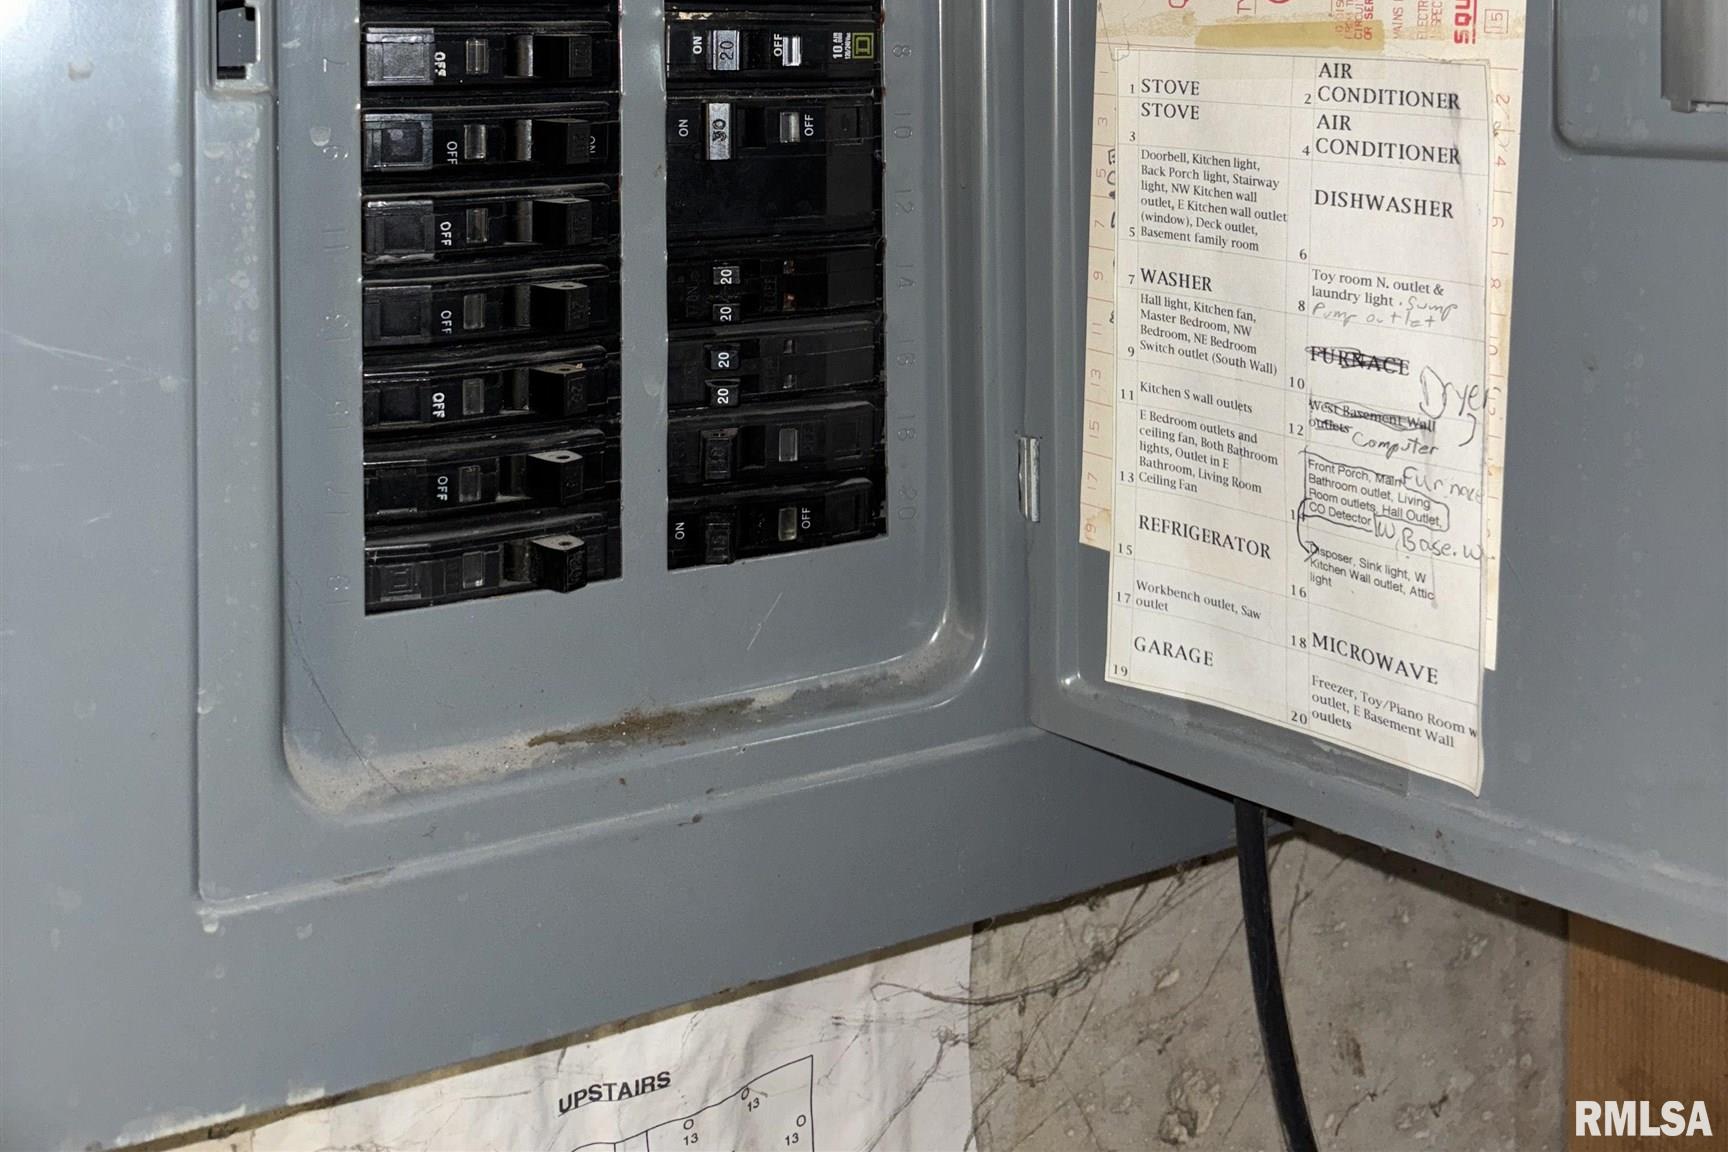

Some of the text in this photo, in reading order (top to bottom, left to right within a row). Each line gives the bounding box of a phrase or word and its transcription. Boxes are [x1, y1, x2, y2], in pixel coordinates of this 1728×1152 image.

[692, 33, 783, 61] ON 20 OFF
[1318, 62, 1352, 80] AIR
[1130, 78, 1200, 96] 1 STOVE
[1304, 85, 1461, 111] 2 CONDITIONER
[1141, 102, 1200, 120] STOVE
[1316, 114, 1352, 131] AIR
[678, 119, 689, 137] ON
[804, 114, 814, 137] OFF
[1129, 131, 1136, 142] 3
[446, 141, 458, 165] OFF
[1141, 149, 1261, 172] Doorbell, Kitchen light,
[1302, 137, 1461, 165] 4 CONDITIONER
[1141, 165, 1280, 191] Back Porch light, Stairway
[1314, 189, 1454, 219] DISHWASHER
[439, 221, 452, 246] OFF
[1129, 226, 1259, 252] 5 Basement family room
[1299, 249, 1308, 261] 6
[720, 268, 733, 285] 20
[1128, 268, 1213, 292] 7 WASHER
[1312, 268, 1445, 296] Toy room N. outlet &
[1298, 300, 1306, 312] 8
[1312, 286, 1393, 307] laundry light
[720, 306, 732, 322] 20
[1140, 294, 1257, 323] Hall light, Kitchen fan,
[440, 310, 452, 335] OFF
[718, 351, 730, 369] 20
[1128, 340, 1278, 376] 9 Switch outlet (South Wall)
[1289, 376, 1305, 390] 10
[717, 388, 729, 405] 20
[1120, 381, 1253, 414] 11 Kitchen S wall outlets
[1288, 423, 1304, 436] 12
[1119, 471, 1198, 493] 13 Ceiling Fan
[1308, 458, 1402, 487] Front Porch, Main
[437, 476, 449, 501] OFF
[675, 507, 811, 541] ON OFF
[1309, 501, 1372, 525] CO Detector
[1139, 514, 1272, 560] REFRIGERATOR
[1118, 543, 1133, 556] 15
[1359, 557, 1382, 572] Sink
[1384, 563, 1411, 582] light,
[1415, 572, 1427, 583] W
[1116, 579, 1262, 620] 17 Workbench outlet, Saw
[1291, 584, 1307, 598] 16
[1134, 636, 1215, 667] GARAGE
[1291, 631, 1439, 685] 18 MICROWAVE
[1113, 664, 1128, 677] 19
[1291, 710, 1352, 730] 20 outlets
[559, 1070, 671, 1115] UPSTAIRS
[747, 1097, 761, 1113] 13
[683, 1133, 699, 1147] 13
[785, 1133, 800, 1147] 13
